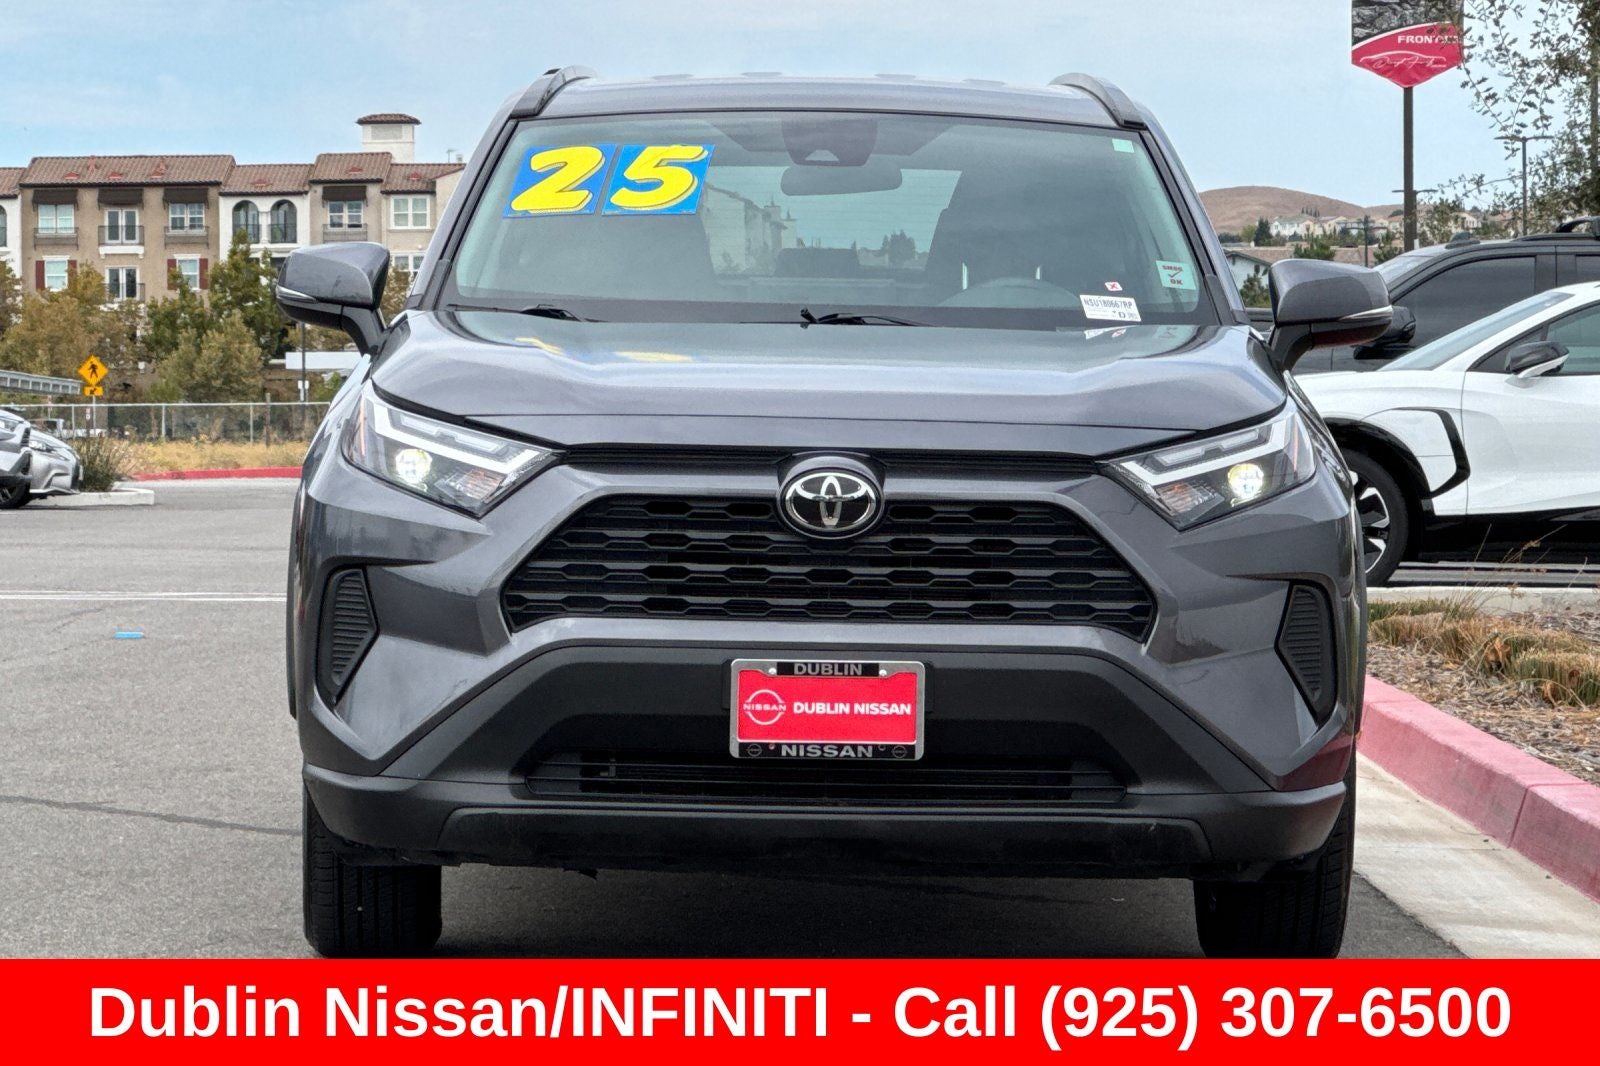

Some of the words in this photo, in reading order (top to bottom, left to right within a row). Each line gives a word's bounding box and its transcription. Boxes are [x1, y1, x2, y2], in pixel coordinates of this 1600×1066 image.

[511, 145, 709, 213] 25
[793, 663, 863, 676] DUBLIN
[743, 703, 787, 711] NISSAN
[793, 701, 850, 715] DUBLIN
[853, 703, 911, 715] NISSAN
[781, 744, 873, 758] NISSAN
